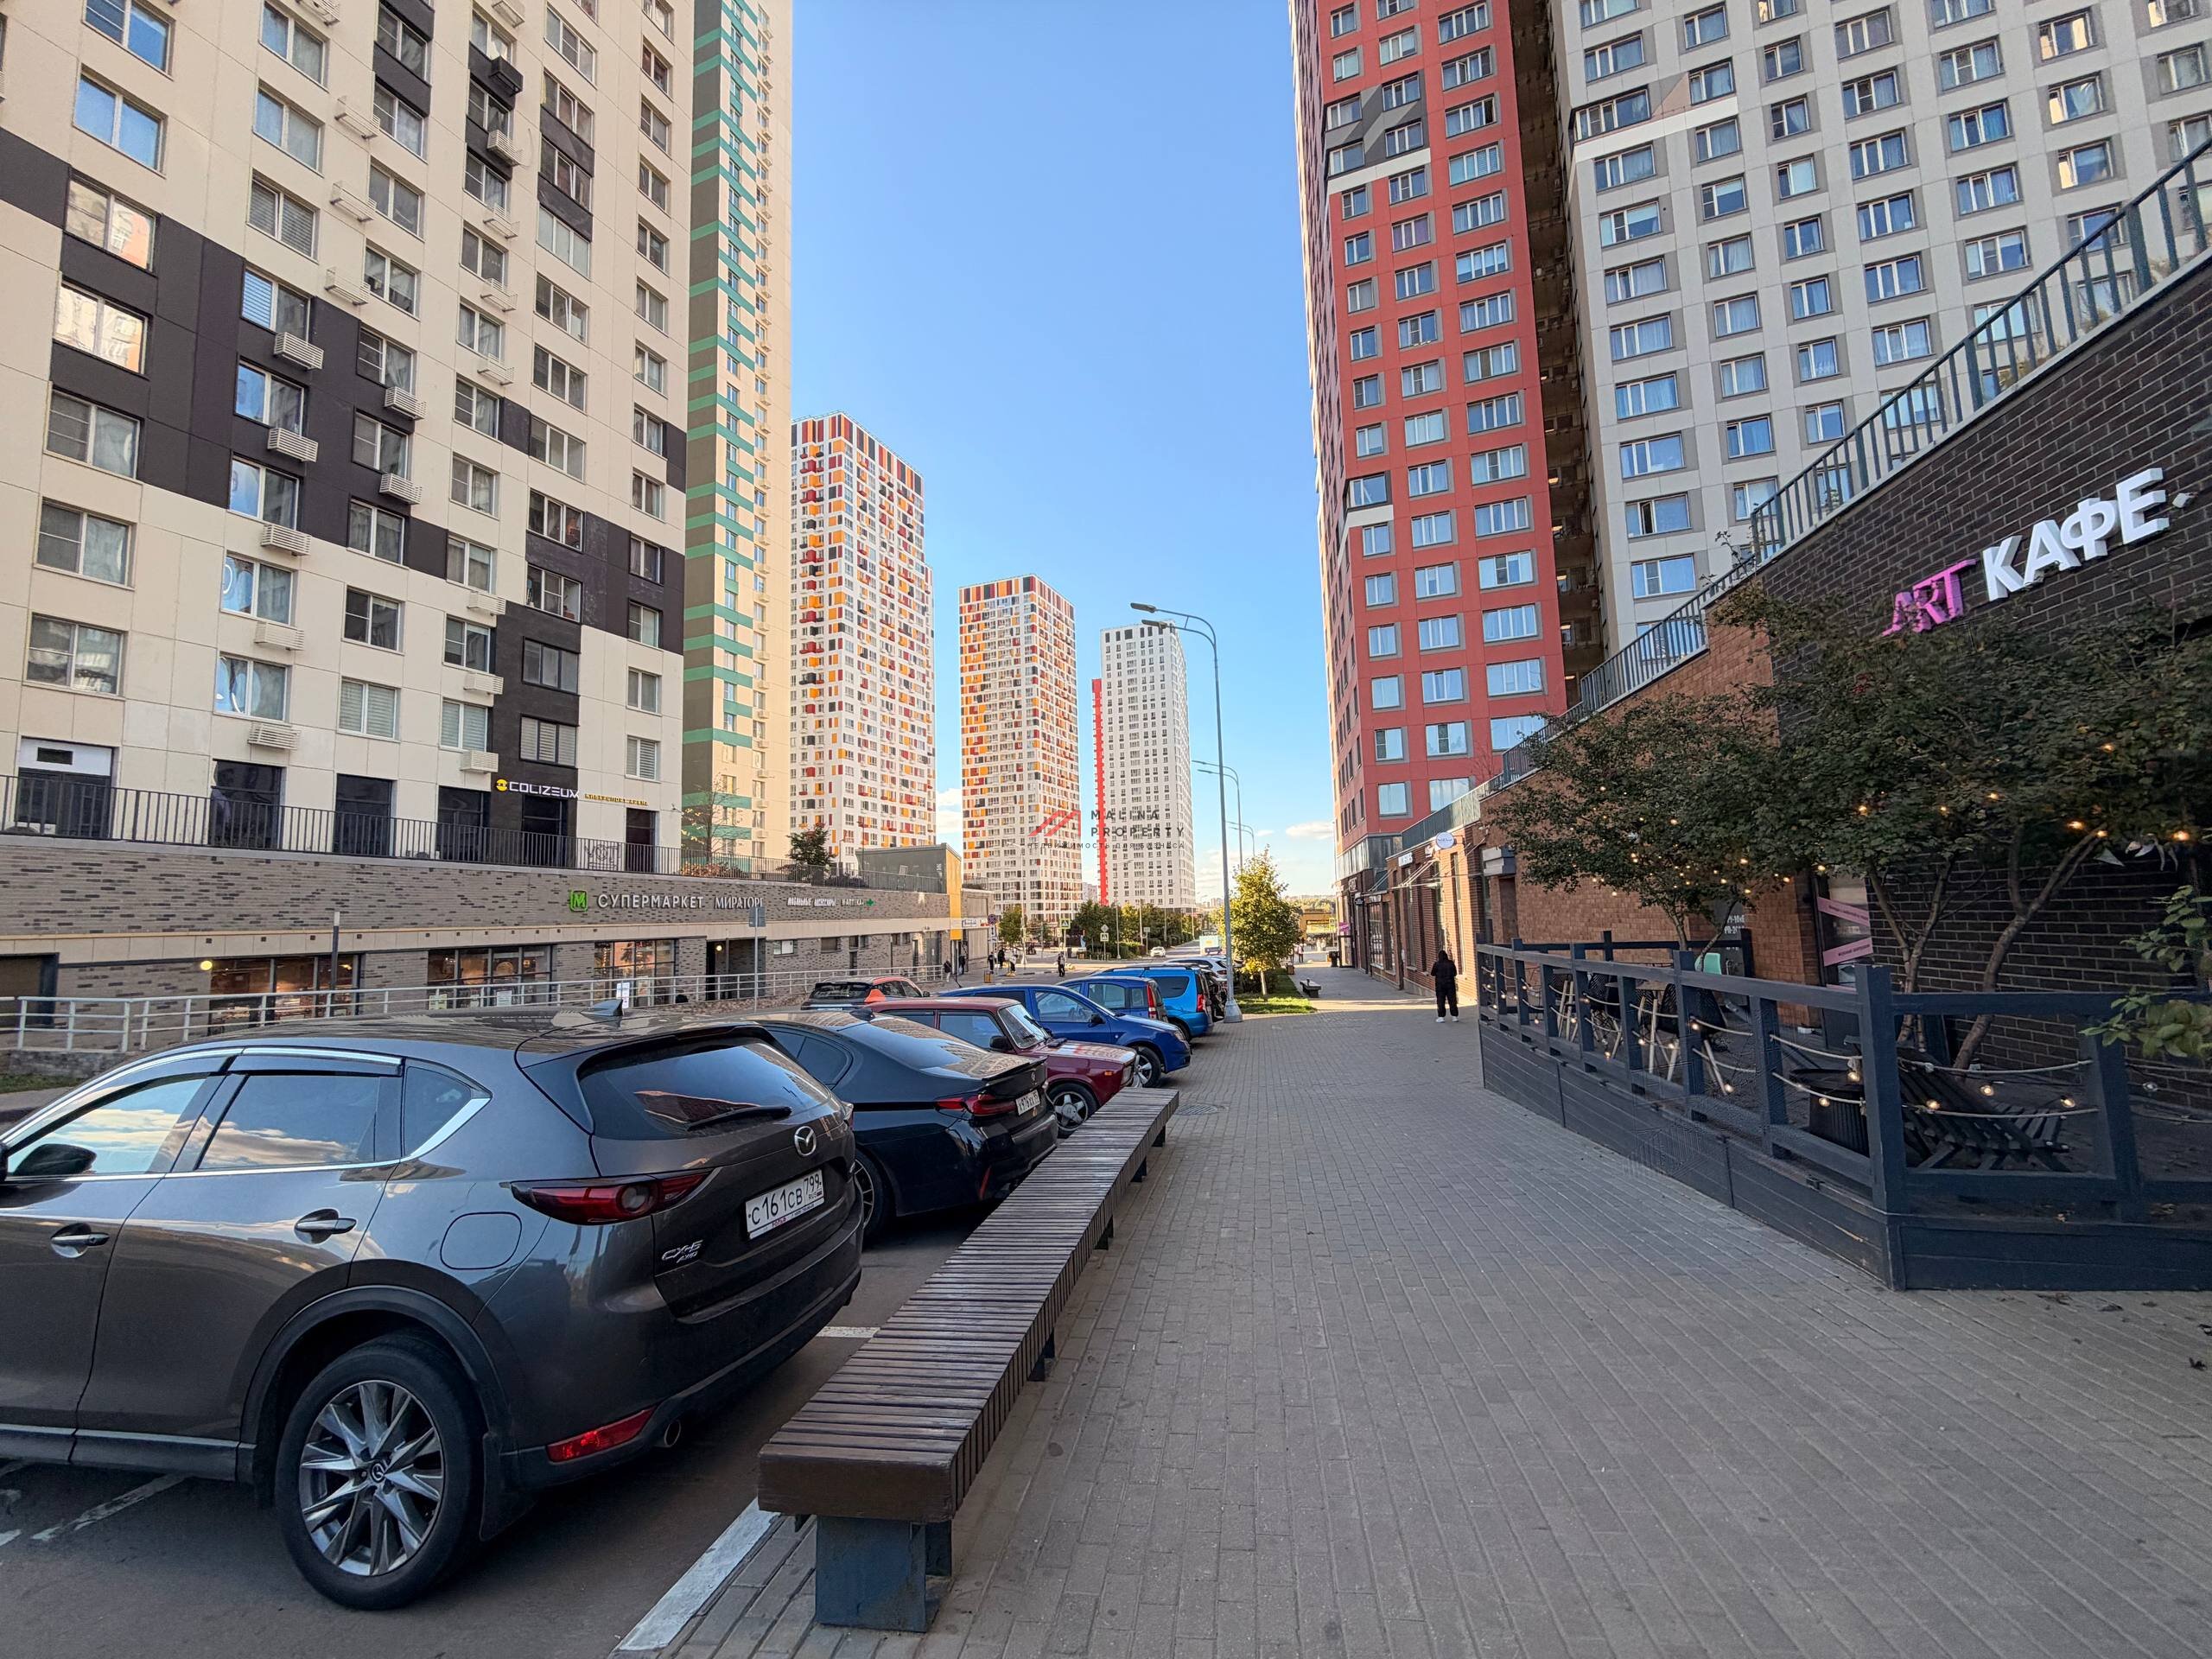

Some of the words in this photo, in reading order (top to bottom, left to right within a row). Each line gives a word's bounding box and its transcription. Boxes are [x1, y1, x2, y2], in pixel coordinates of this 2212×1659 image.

[1881, 558, 1977, 637] ART
[1982, 467, 2171, 602] КАФЕ
[598, 893, 704, 908] СУПЕРМАРКЕТ
[715, 896, 764, 909] МИРАТОРГ
[804, 1173, 820, 1196] 799
[662, 1240, 703, 1261] CX-5
